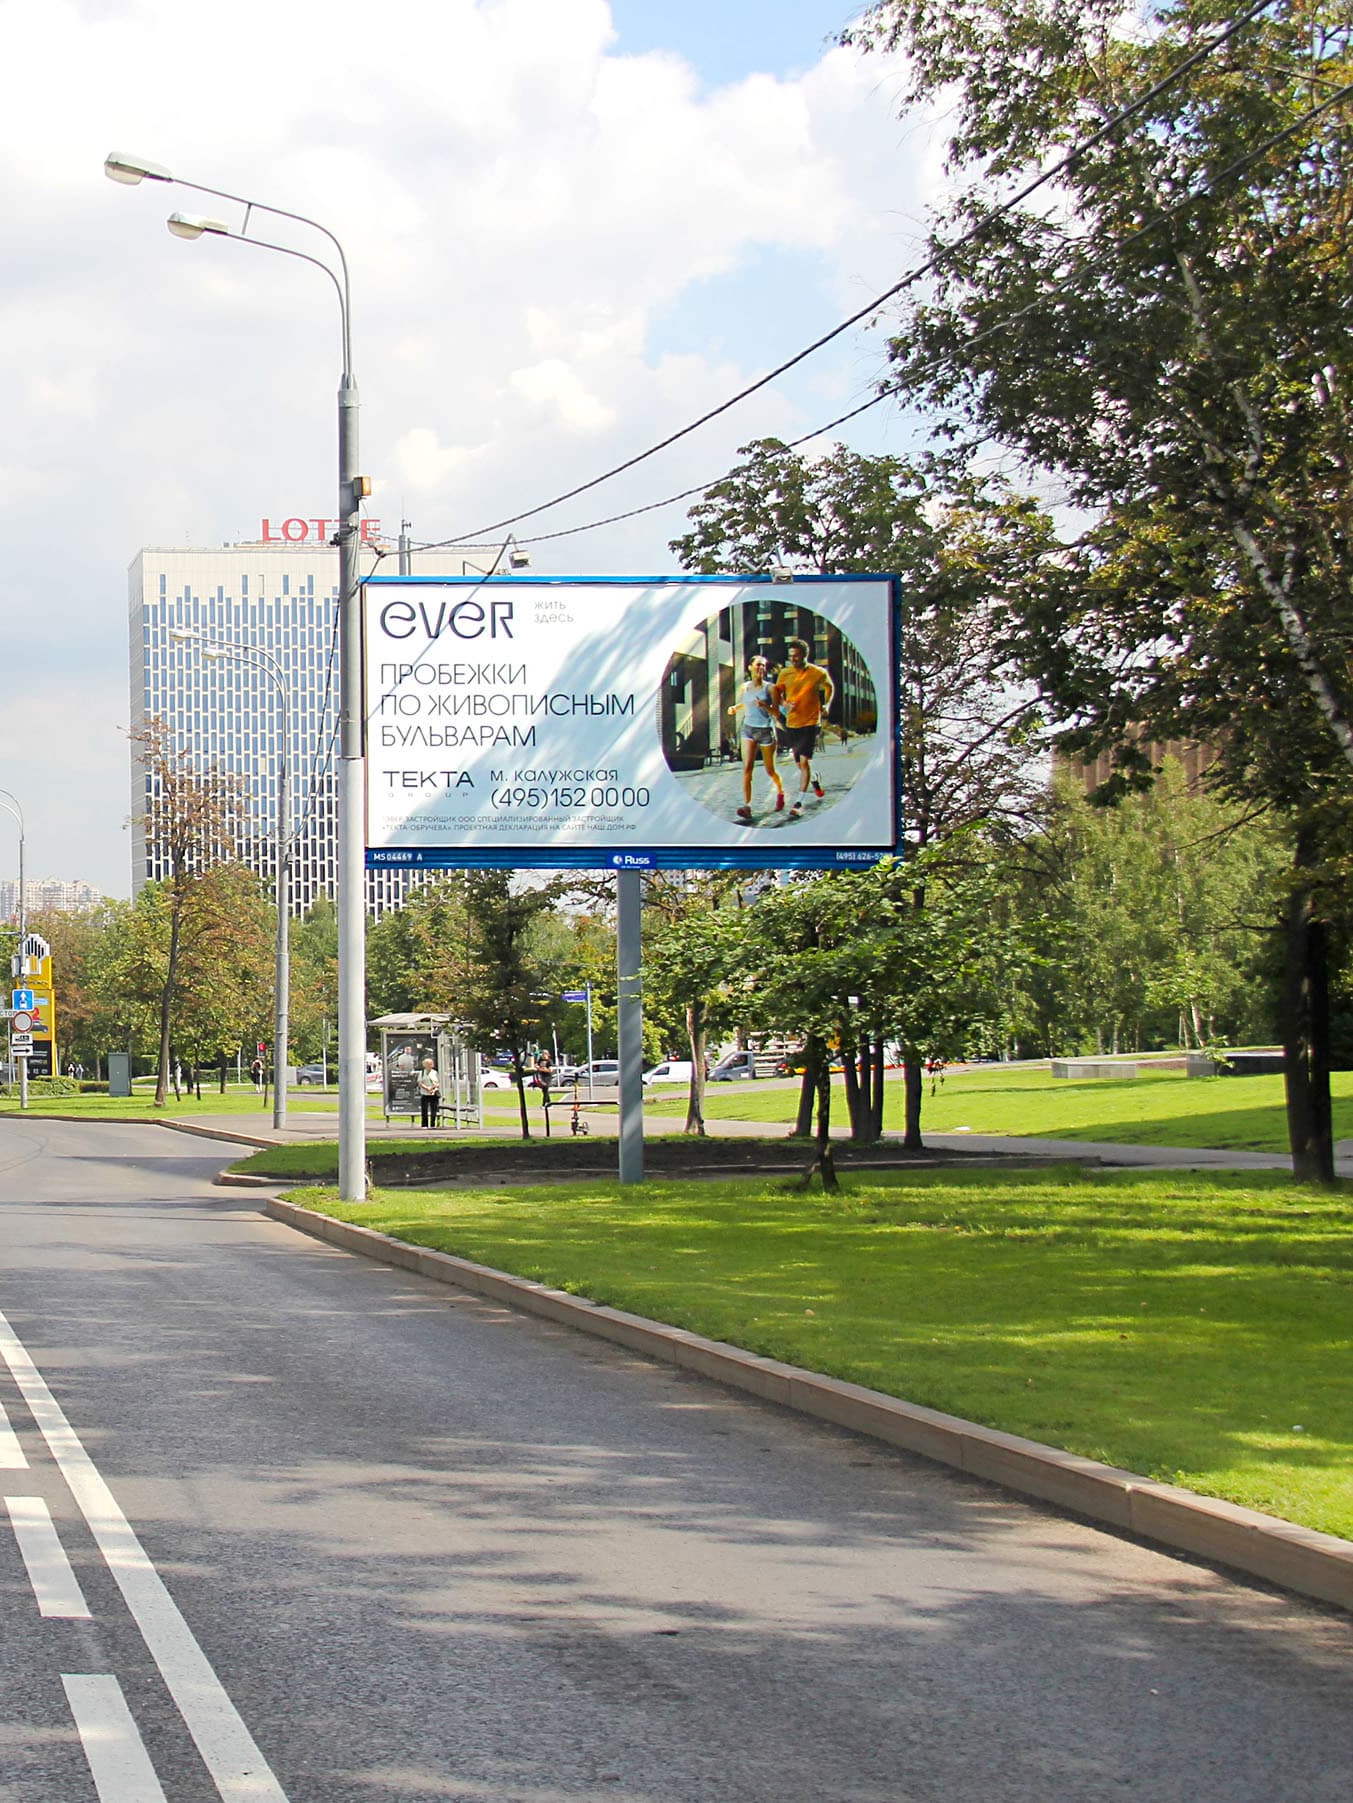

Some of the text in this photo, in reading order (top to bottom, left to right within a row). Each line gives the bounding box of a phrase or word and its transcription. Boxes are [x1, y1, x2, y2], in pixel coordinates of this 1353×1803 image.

[261, 518, 381, 541] LOTE
[380, 663, 527, 685] ПРОБЕЖКИ
[380, 693, 635, 715] ПО ЖИВОПИСНЫМ
[381, 725, 537, 747] БУЛЬВАРАМ
[382, 770, 475, 788] ТЕКТА
[624, 855, 650, 865] Russ
